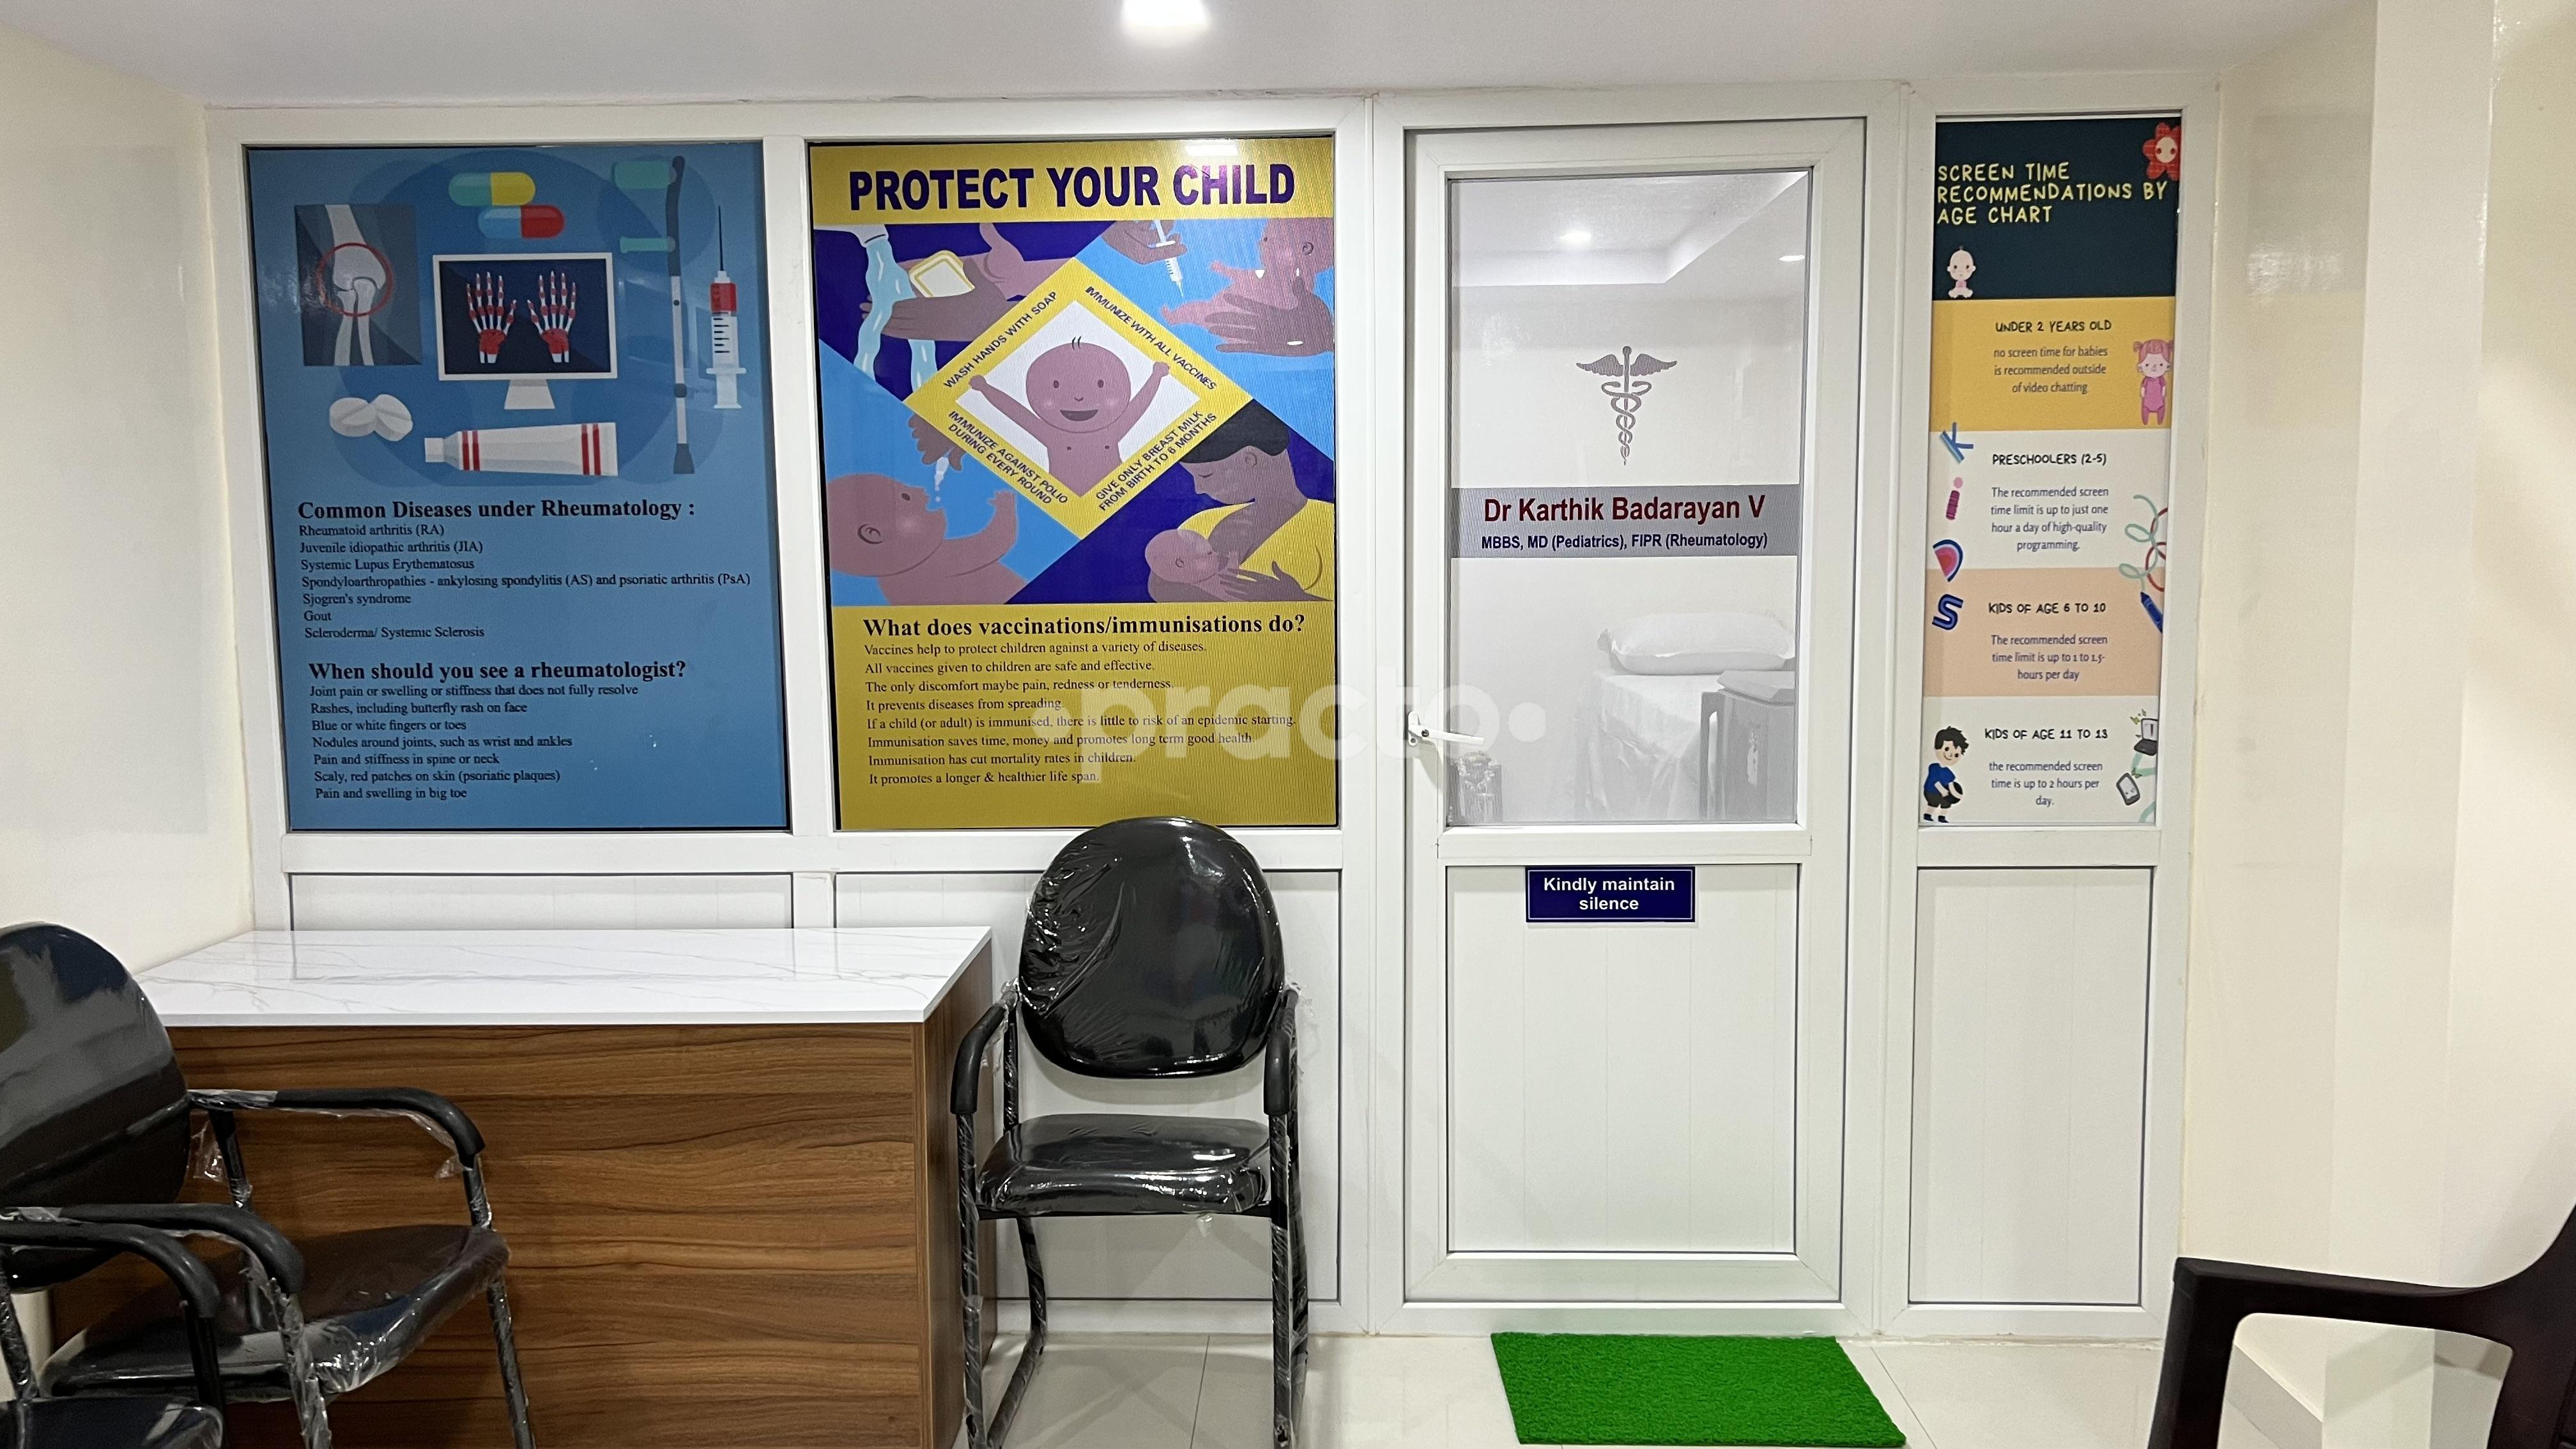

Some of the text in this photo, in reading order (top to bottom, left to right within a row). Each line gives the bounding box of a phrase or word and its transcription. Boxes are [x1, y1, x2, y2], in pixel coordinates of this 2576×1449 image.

[1938, 161, 2070, 182] SCREEN TIME
[849, 163, 1295, 211] PROTECT YOUR CHILD
[1938, 181, 2167, 204] RECOMMENDATIONS BY
[1937, 205, 2052, 226] AGE CHART
[1995, 319, 2112, 333] UNDER 2 YEARS OLD
[944, 291, 1057, 388] WASH HANDS WITH SOAP
[1085, 286, 1216, 390] IMMUNIZE WITH ALL VACCINES
[1993, 345, 2108, 358] no screen time for babies
[1994, 364, 2106, 376] is recommended outside
[2012, 381, 2023, 393] of
[2023, 381, 2048, 393] video
[948, 424, 1052, 504] DURING EVERY ROUND
[949, 411, 1068, 503] IMMUNIZE AGAINST POLIO
[1096, 411, 1203, 500] GIVE ONLY BREAST MILK
[1099, 487, 1128, 511] FROM
[1125, 464, 1156, 489] BIRTH
[1154, 453, 1169, 466] TO
[1175, 413, 1217, 448] MONTHS
[1992, 453, 2107, 466] PRESCHOOLERS (2-5)
[298, 502, 386, 519] Common
[392, 501, 471, 518] Diseases
[478, 500, 536, 518] under
[540, 500, 682, 521] Rheumatology
[1484, 494, 1766, 523] Dr Karthik Badarayan V
[299, 524, 445, 537] Rheumatoid arthritis (RA)
[300, 540, 483, 555] Juvenile idiopathic arthritis (JIA)
[1482, 532, 1768, 551] MBBS, MD (Pediatrics), FIPR (Rheumatology)
[301, 558, 475, 572] Systemic Lupus Erythematosus
[302, 575, 426, 590] Spondyloarthropathies
[437, 574, 498, 589] ankylosing
[501, 574, 563, 588] spondylitis
[565, 574, 593, 588] (AS)
[595, 574, 617, 585] and
[619, 573, 668, 588] psoriatic
[671, 573, 714, 585] arthritis
[717, 573, 751, 586] (PsA)
[303, 592, 411, 608] Sjogren's syndrome
[1988, 602, 2106, 615] KIDS OF AGE 6 TO 10
[303, 610, 332, 622] Gout
[381, 627, 432, 640] Systemic
[434, 626, 485, 638] Sclerosis
[862, 614, 1305, 636] What does vaccinations/immunisations do?
[864, 640, 1207, 657] Vaccines help to protect children against a variety of diseases.
[308, 660, 686, 683] When should you see a rheumatologist?
[309, 684, 638, 698] Joint pain or swelling or stiffness that does not fully resolve
[311, 719, 467, 733] Blue or white fingers or toes
[1984, 728, 2108, 740] KIDS OF AGE 11 TO 13
[314, 769, 561, 785] Scaly, red patches on skin (psoriatic plaques)
[1544, 877, 1675, 894] Kindly maintain
[1579, 896, 1639, 910] silence
